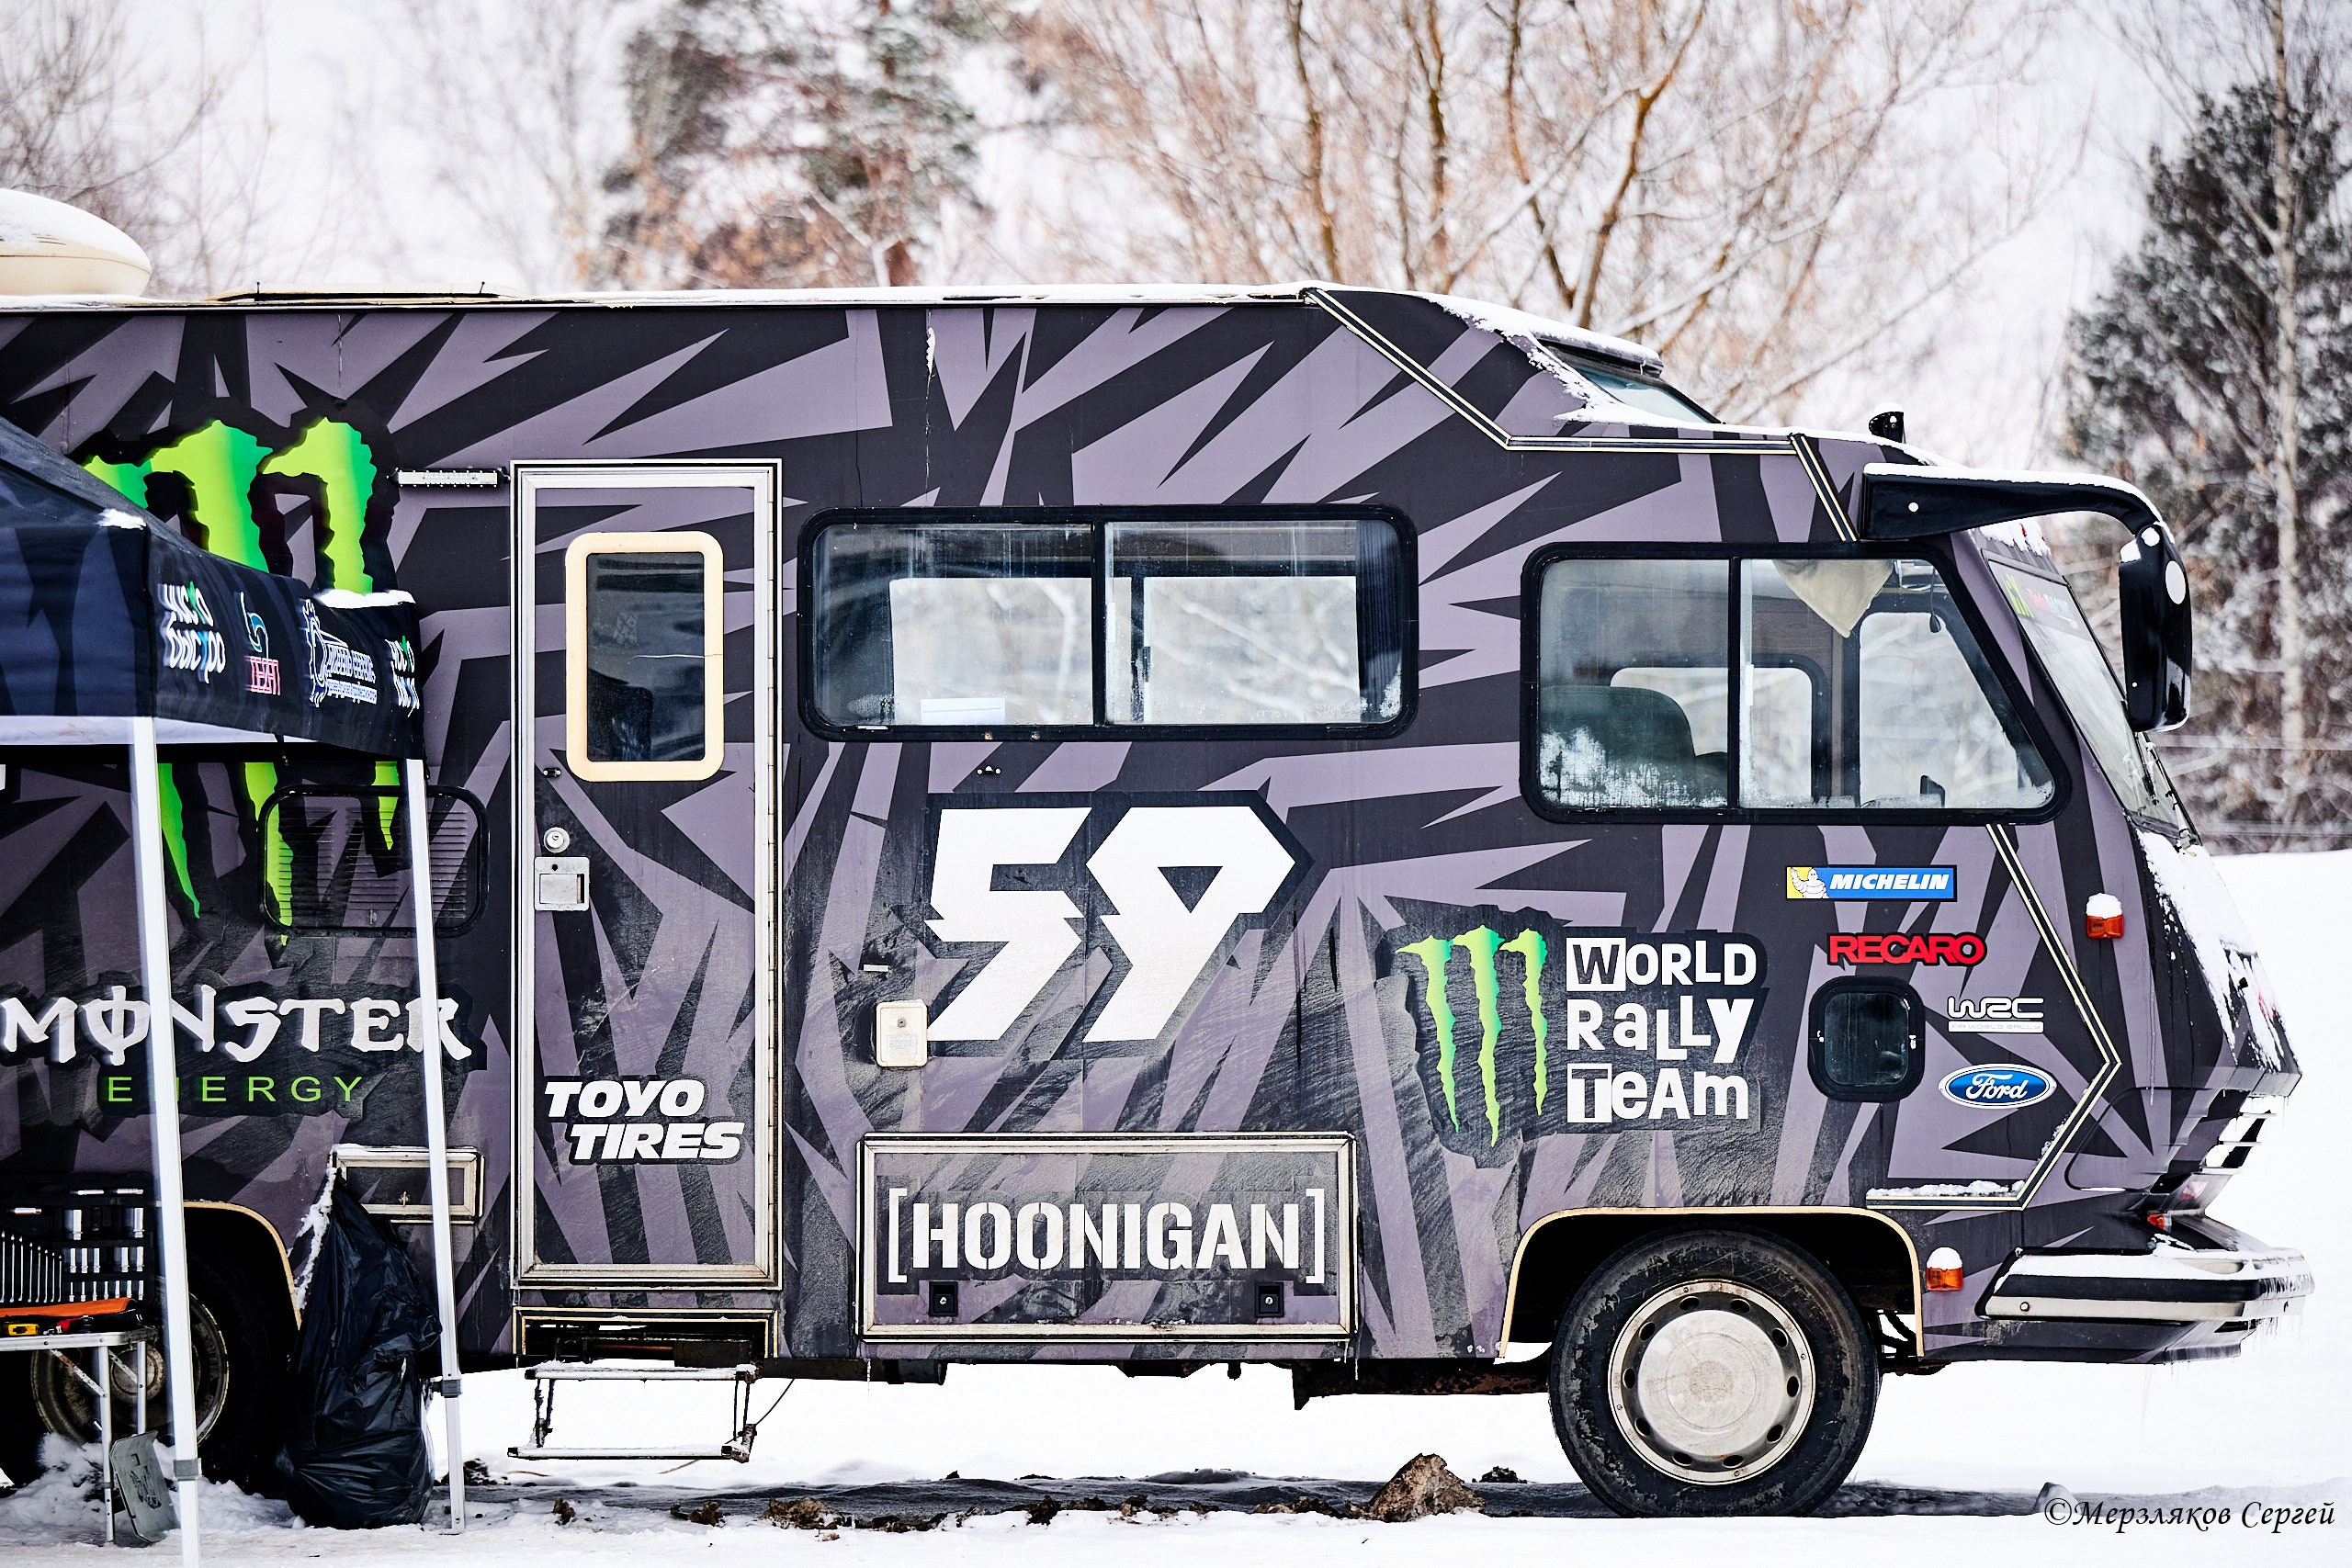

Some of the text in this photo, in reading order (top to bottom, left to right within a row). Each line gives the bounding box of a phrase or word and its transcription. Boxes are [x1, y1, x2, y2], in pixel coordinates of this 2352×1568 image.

[1830, 874, 1950, 890] MICHELIN
[923, 806, 1295, 1043] 59
[1829, 934, 1985, 964] RECARO
[1948, 997, 2044, 1019] WRC
[108, 1077, 362, 1102] EERGY
[544, 1081, 706, 1119] TOYO
[1965, 1073, 2029, 1100] Ford
[570, 1122, 745, 1161] TIRES
